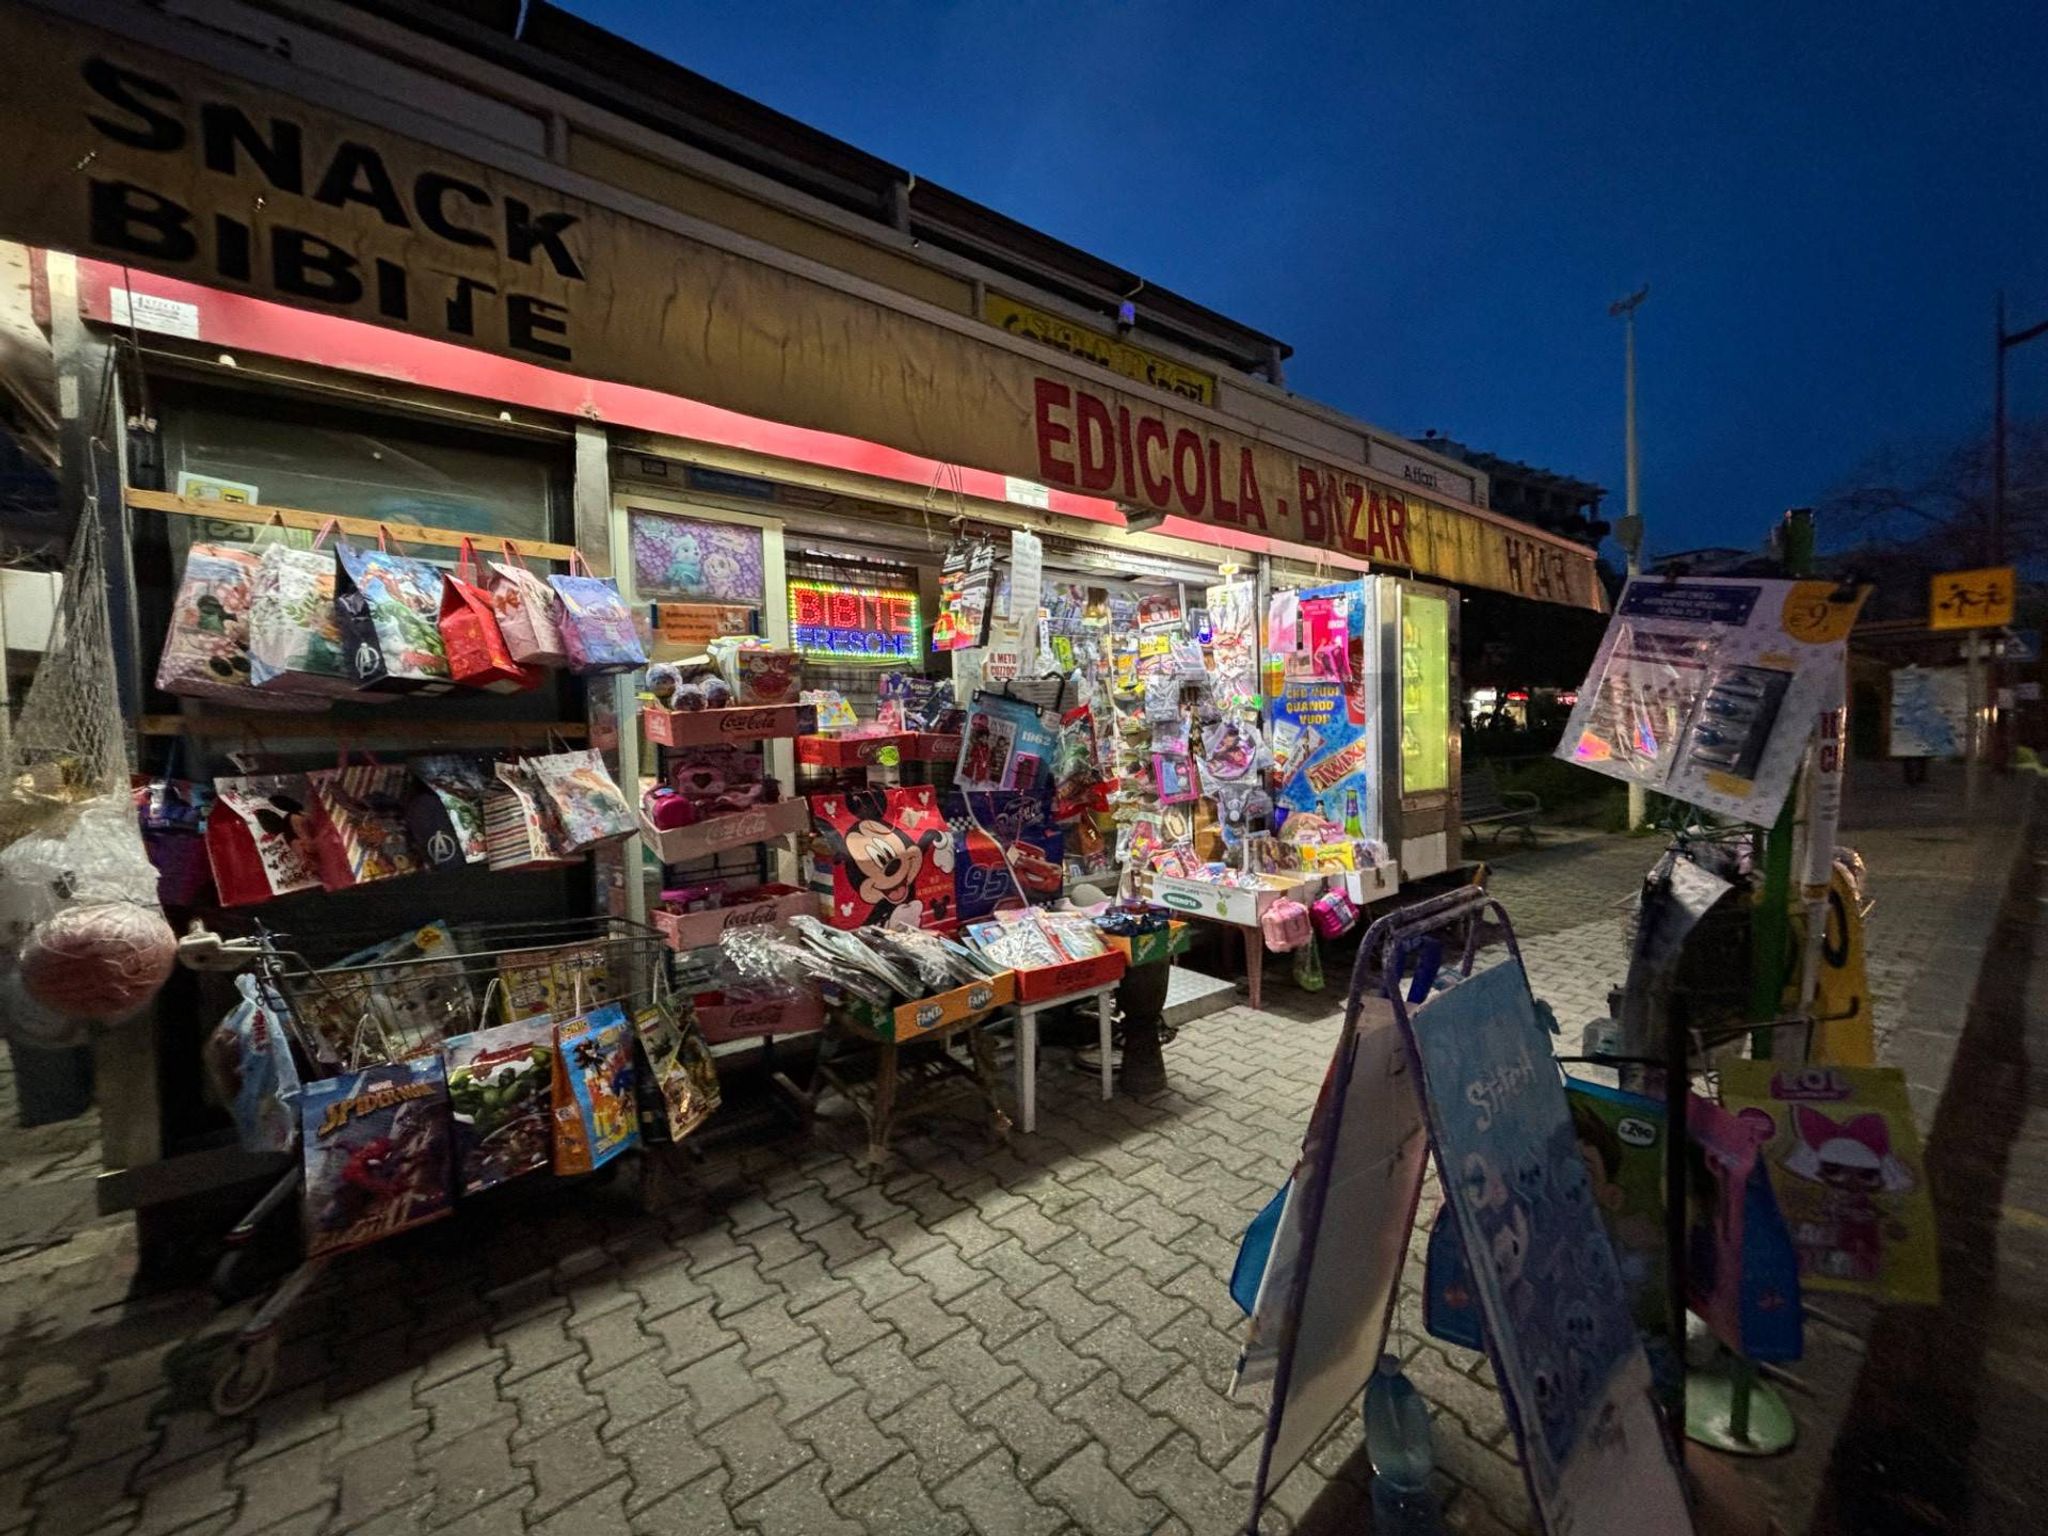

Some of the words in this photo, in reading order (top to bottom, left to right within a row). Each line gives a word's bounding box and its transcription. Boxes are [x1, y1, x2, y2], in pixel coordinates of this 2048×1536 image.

[80, 56, 586, 280] SNACK
[88, 178, 573, 362] BIBITE
[1034, 377, 1268, 530] EDICOLA
[794, 587, 913, 633] BIBITE
[796, 627, 913, 656] FRESCHE
[1286, 700, 1336, 714] QUANDO
